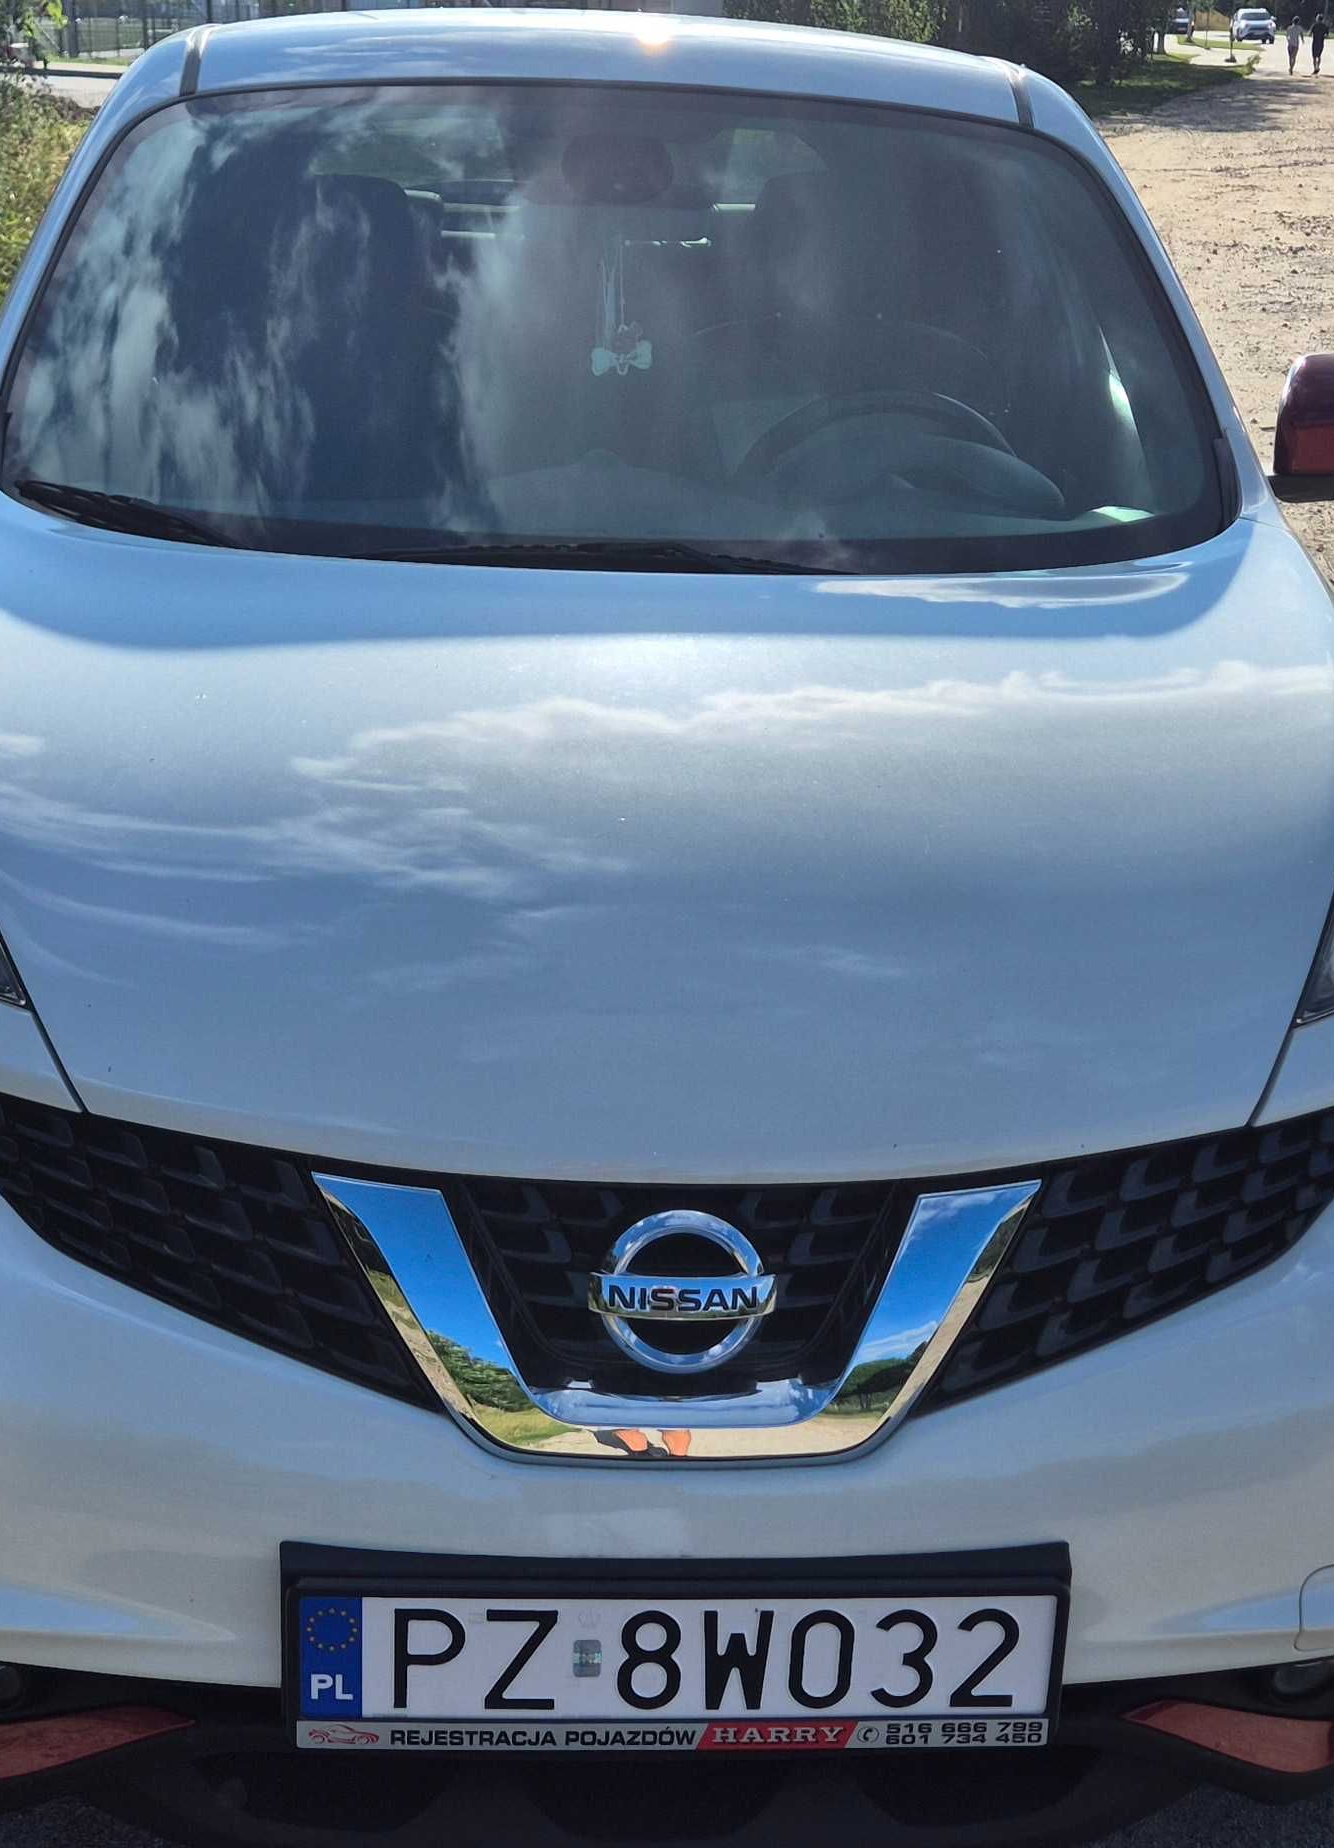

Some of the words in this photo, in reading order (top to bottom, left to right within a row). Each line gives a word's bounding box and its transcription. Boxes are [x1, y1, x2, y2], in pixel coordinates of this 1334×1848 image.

[608, 1285, 758, 1312] NISSAN
[393, 1608, 559, 1710] PZ
[616, 1607, 1020, 1710] 8W032
[310, 1673, 354, 1700] PL
[390, 1729, 557, 1746] REJESTRACJA
[564, 1726, 696, 1747] POJAZDÓW
[711, 1726, 845, 1744] HARRY
[885, 1734, 929, 1745] 601
[941, 1733, 987, 1744] 734
[886, 1722, 933, 1734] 516
[941, 1722, 988, 1733] 666
[997, 1721, 1044, 1733] 799
